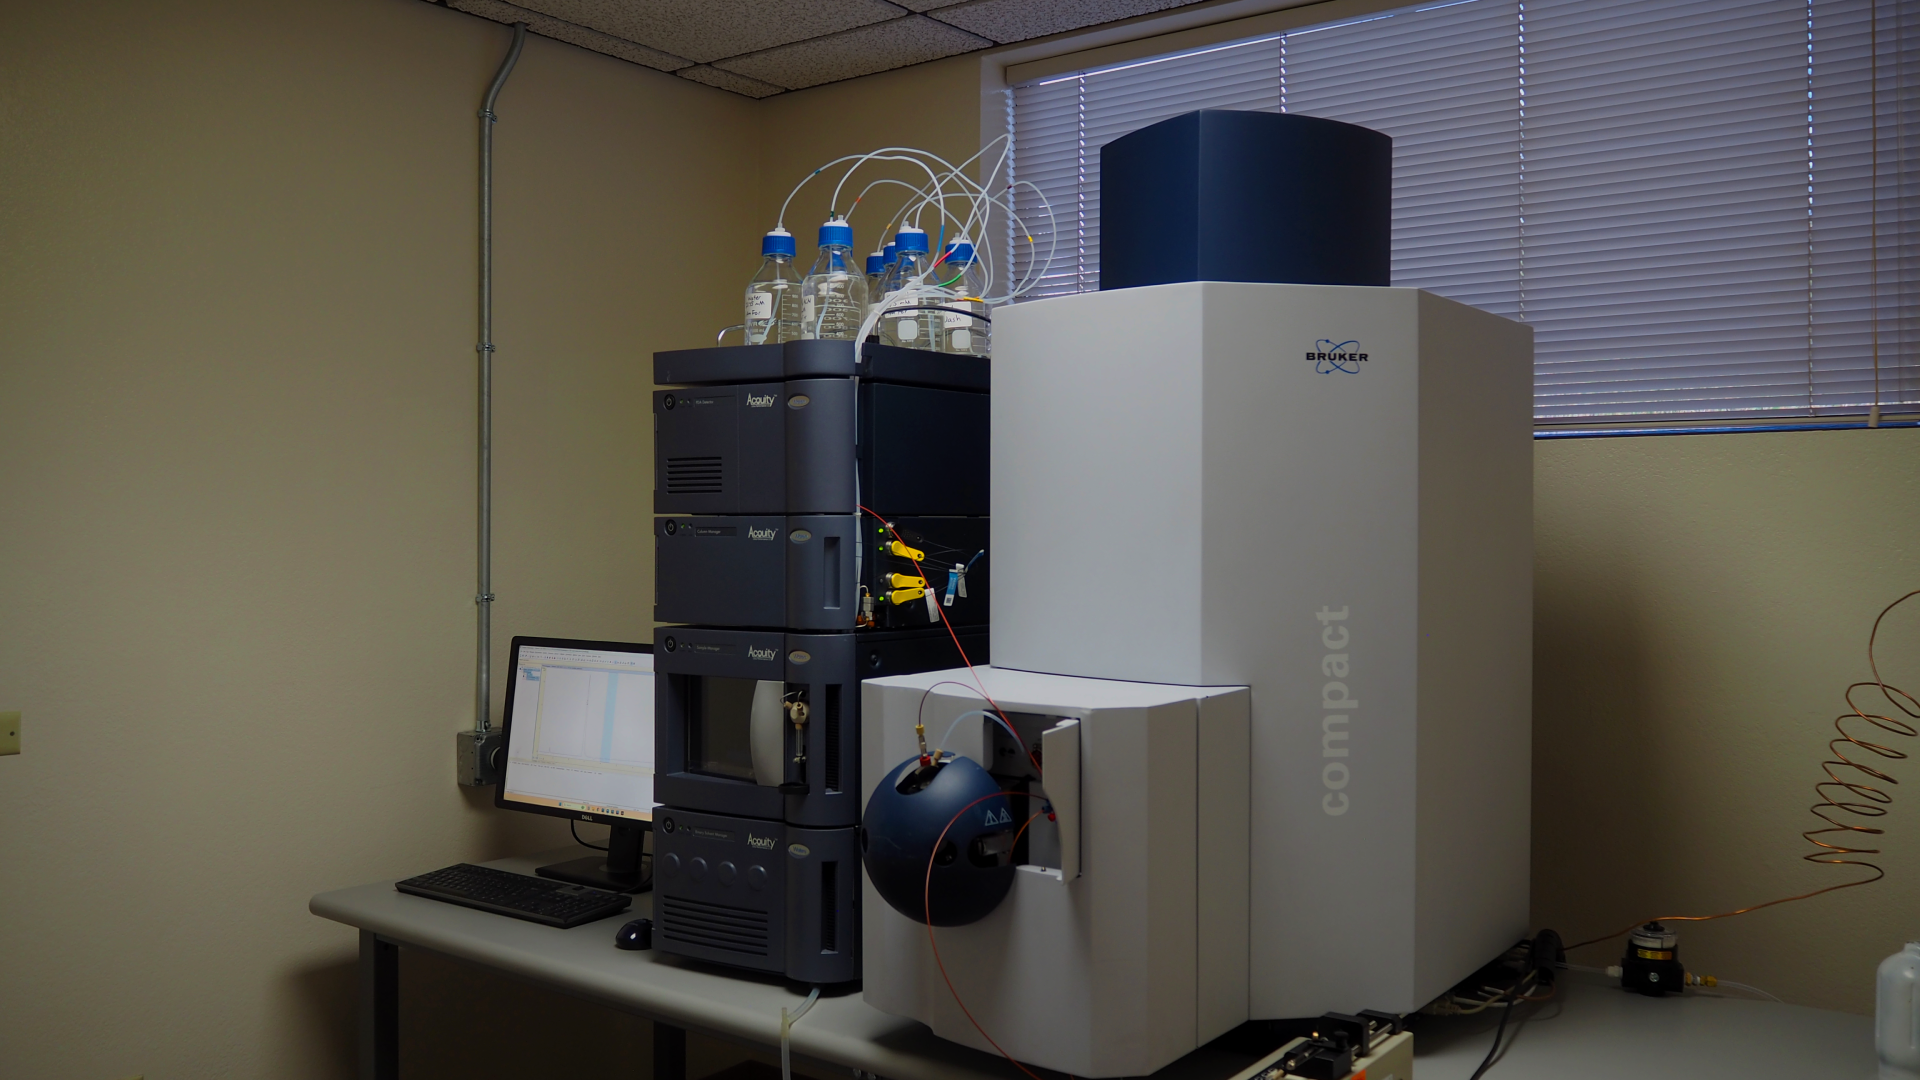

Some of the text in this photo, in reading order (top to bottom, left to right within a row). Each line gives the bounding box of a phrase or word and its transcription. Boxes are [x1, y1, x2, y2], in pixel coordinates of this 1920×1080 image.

[1306, 352, 1369, 362] BRUKER
[746, 392, 775, 408] Acquity
[748, 525, 777, 541] Acquity
[748, 645, 777, 661] Acquity
[1315, 605, 1359, 817] compact
[747, 832, 776, 850] Acquity
